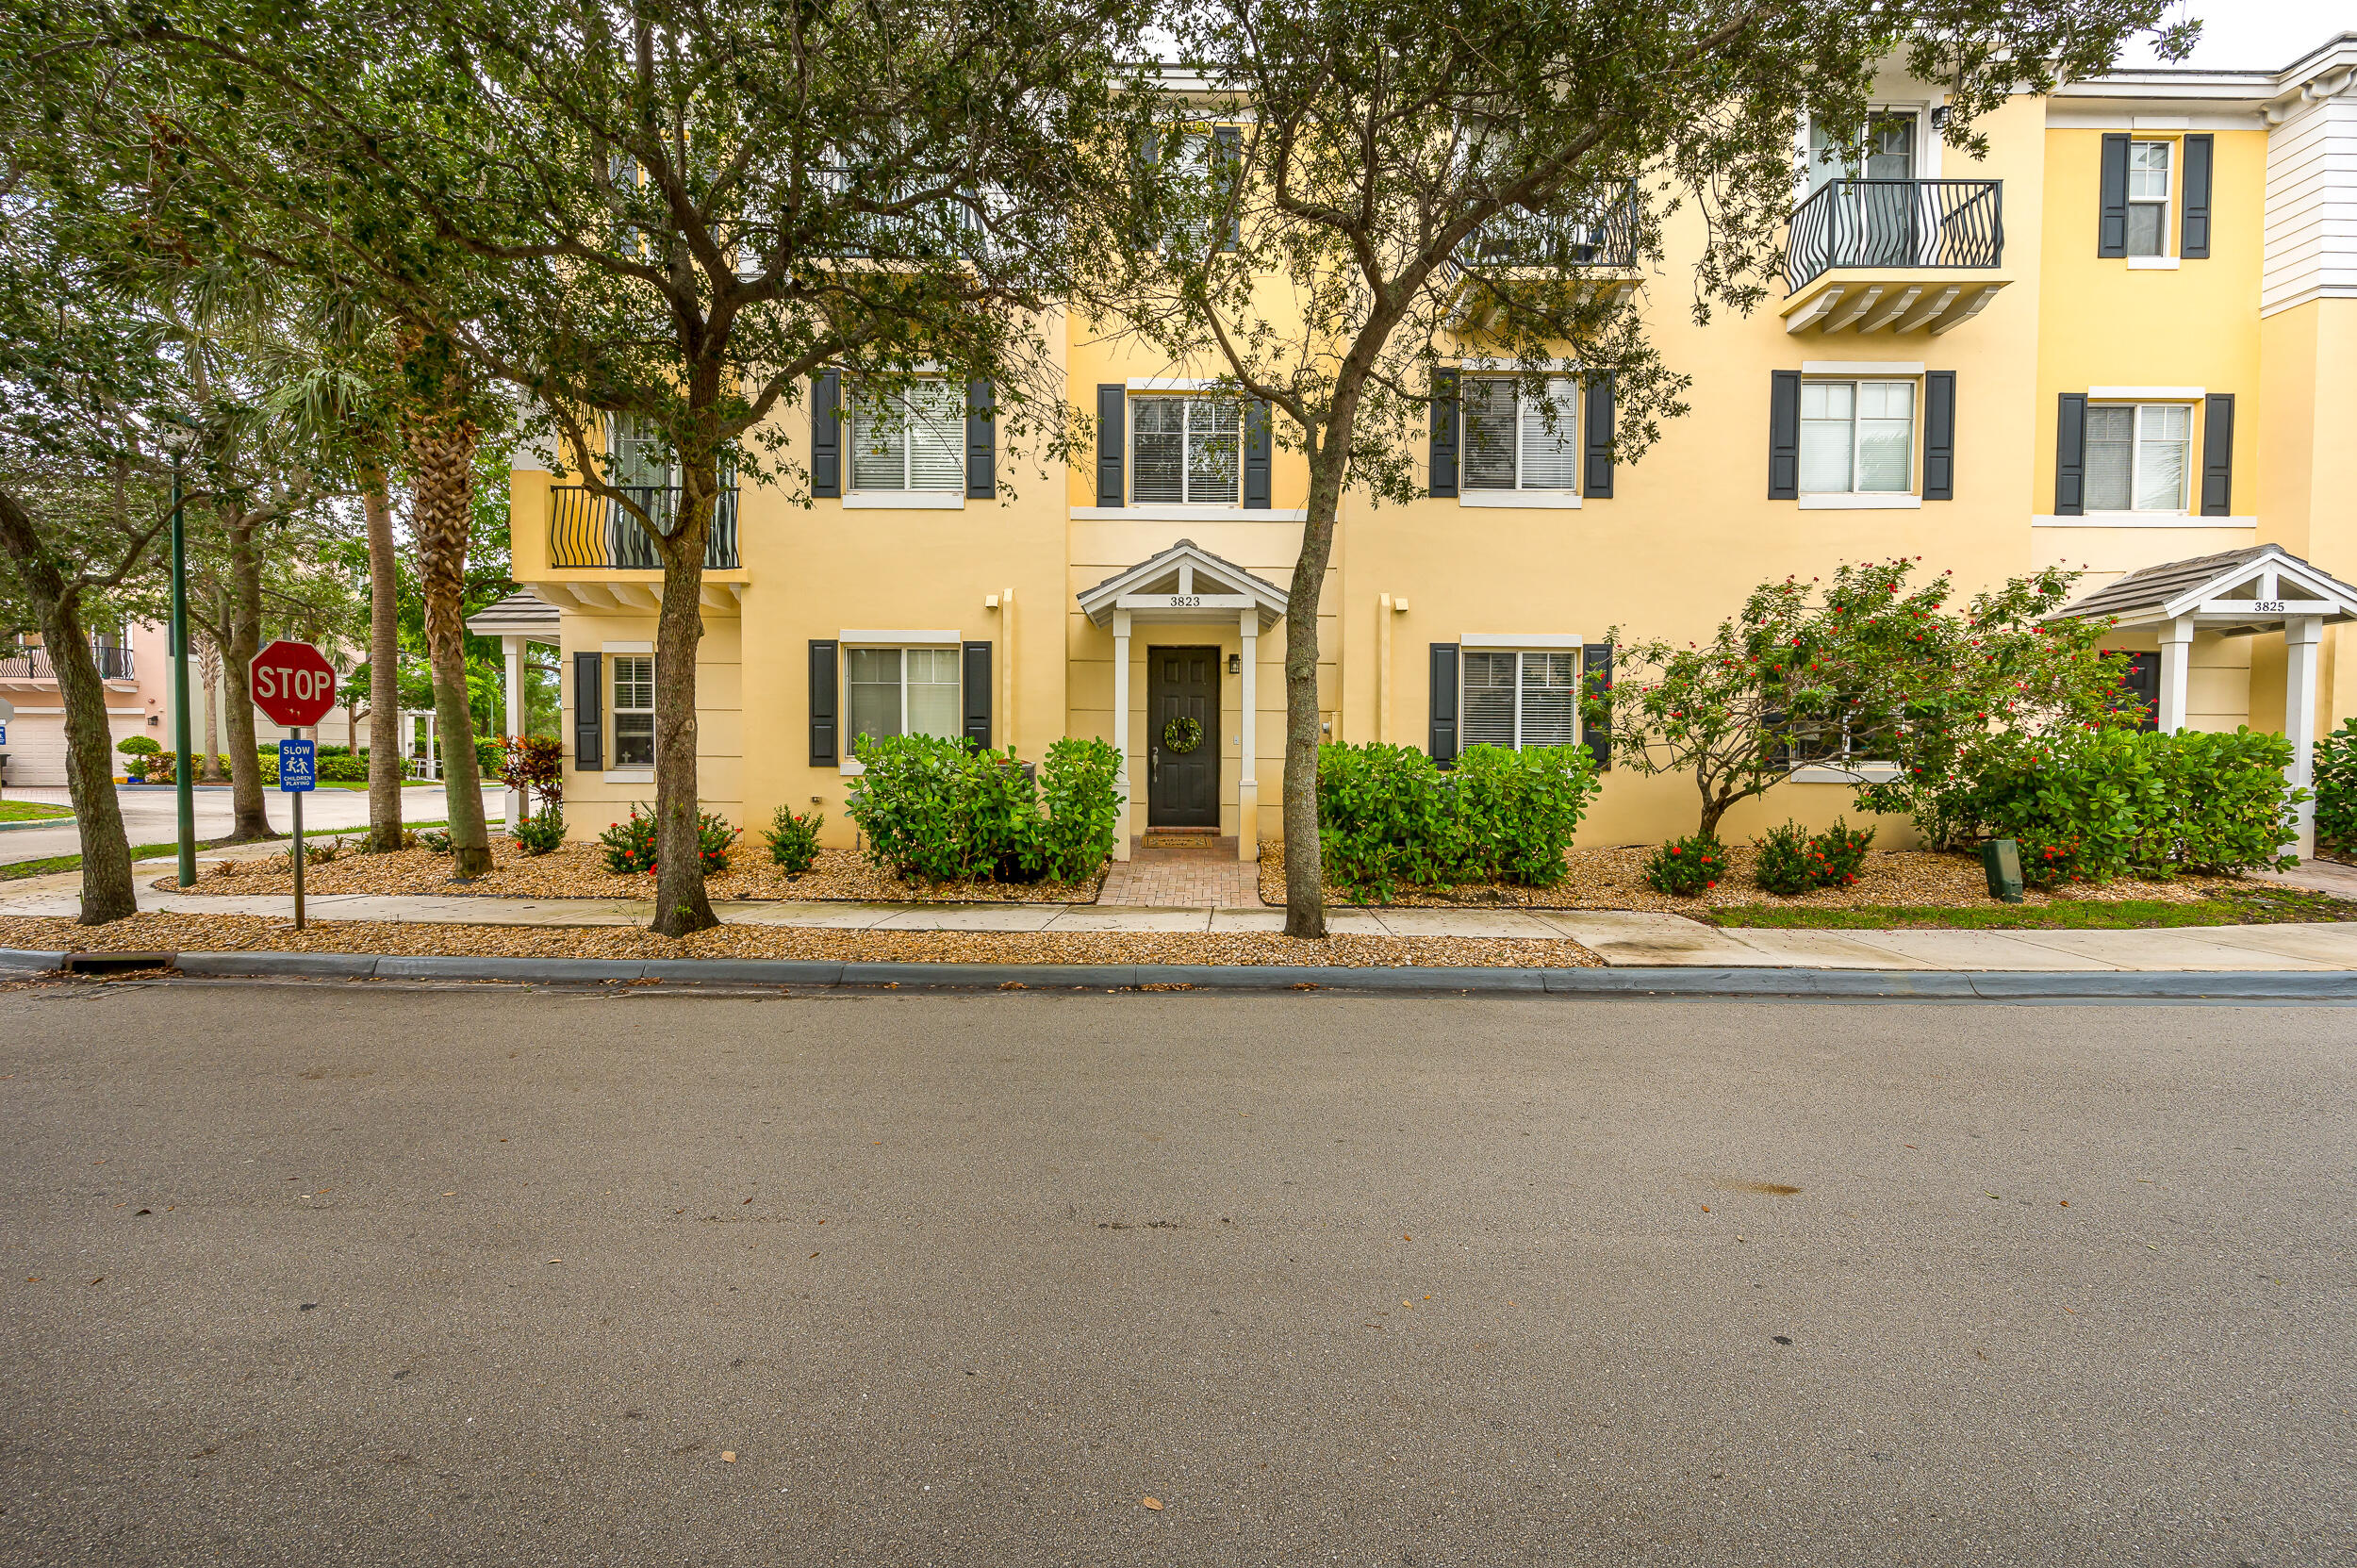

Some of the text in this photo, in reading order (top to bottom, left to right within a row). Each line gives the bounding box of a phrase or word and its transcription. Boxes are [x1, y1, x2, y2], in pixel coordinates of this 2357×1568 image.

[1170, 596, 1200, 606] 3823
[2254, 602, 2284, 612] 3825
[257, 666, 331, 701] STOP
[283, 746, 310, 754] SLOW
